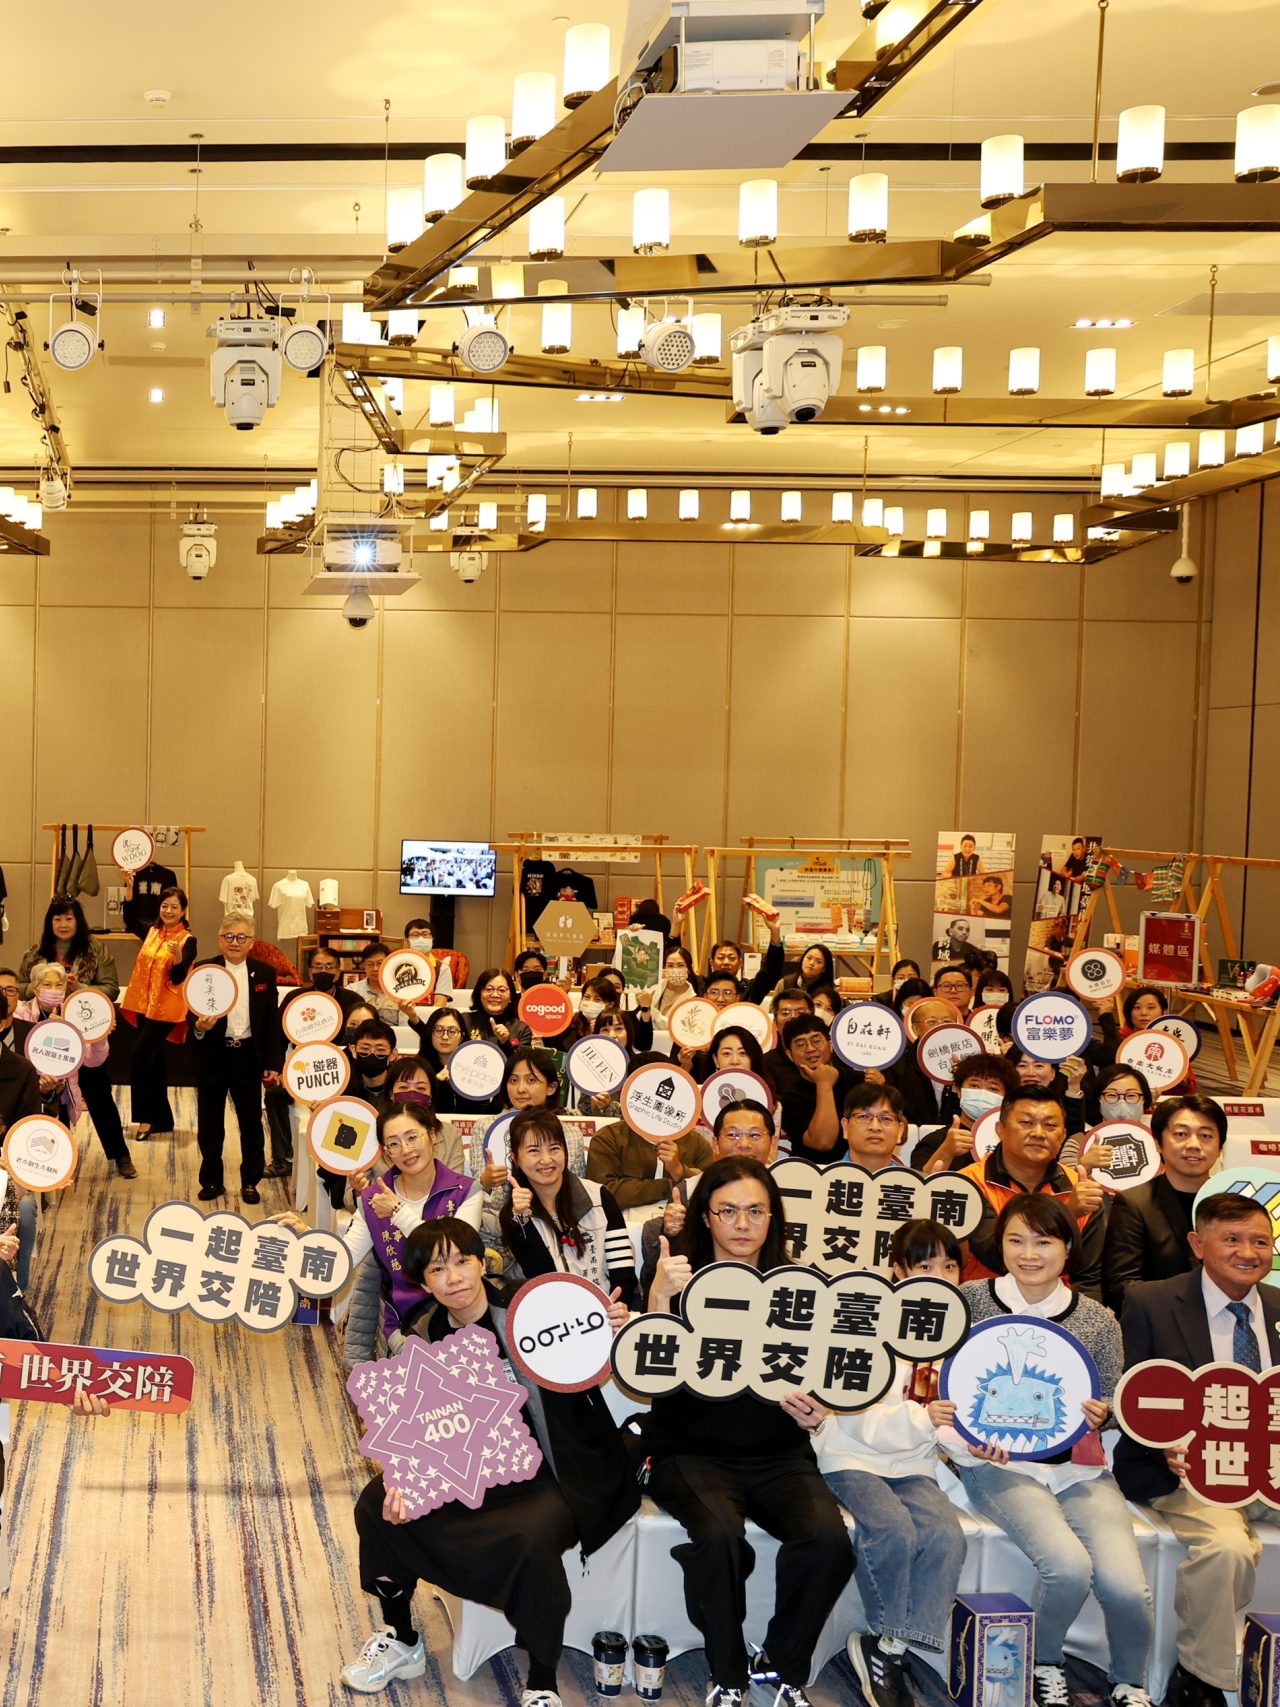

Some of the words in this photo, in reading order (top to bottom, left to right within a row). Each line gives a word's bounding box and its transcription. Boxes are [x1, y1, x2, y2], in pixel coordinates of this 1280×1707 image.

[1148, 943, 1190, 957] 媒體區
[526, 1003, 565, 1016] cogood
[1025, 1015, 1074, 1025] FLOMO
[927, 1038, 973, 1058] 劍橋飯店
[1026, 1027, 1074, 1041] 富樂夢
[297, 1071, 340, 1090] PUNCH
[628, 1101, 652, 1118] Graphic
[663, 1117, 682, 1130] Studio
[1225, 1105, 1263, 1114] 明星花露水
[780, 1178, 970, 1228] 一起臺南
[160, 1223, 335, 1283] 一起臺南
[105, 1250, 282, 1319] 世界交陪
[704, 1287, 949, 1342] 一起臺南
[633, 1333, 872, 1392] 世界交陪
[20, 1353, 175, 1403] 世界交陪
[416, 1401, 465, 1425] TAINAN
[1138, 1384, 1280, 1429] 一起
[424, 1413, 472, 1444] 400
[1202, 1440, 1280, 1487] 世
